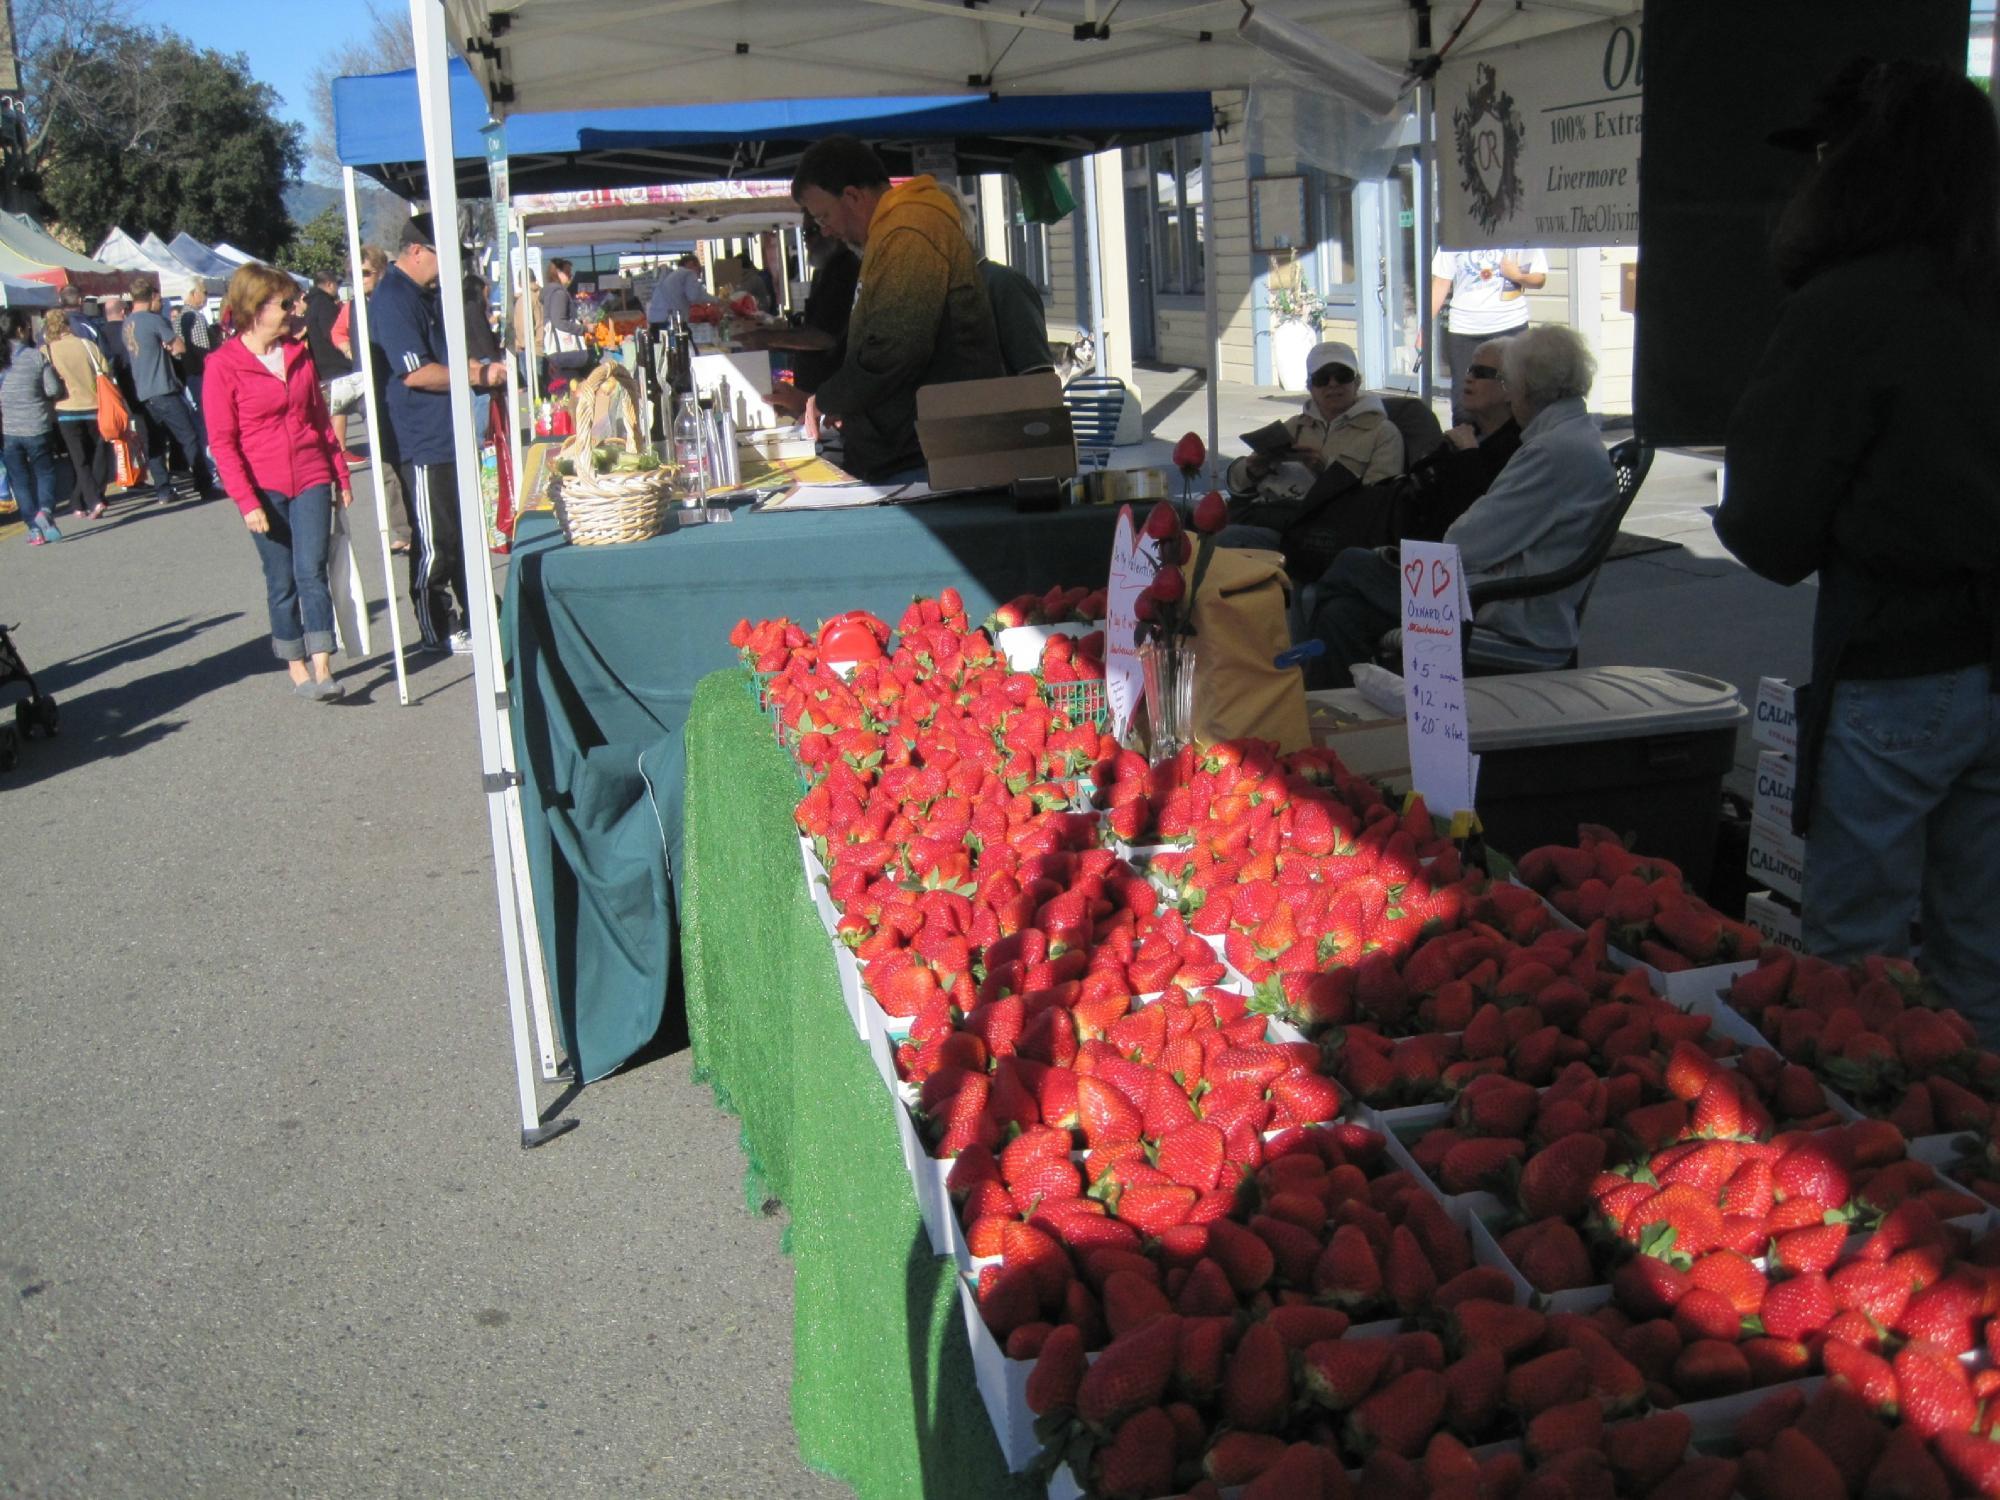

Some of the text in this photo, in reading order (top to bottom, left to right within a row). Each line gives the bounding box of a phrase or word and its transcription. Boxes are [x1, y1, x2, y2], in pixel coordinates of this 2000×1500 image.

[1551, 112, 1642, 145] 100% Extra
[1547, 166, 1627, 192] Livermore
